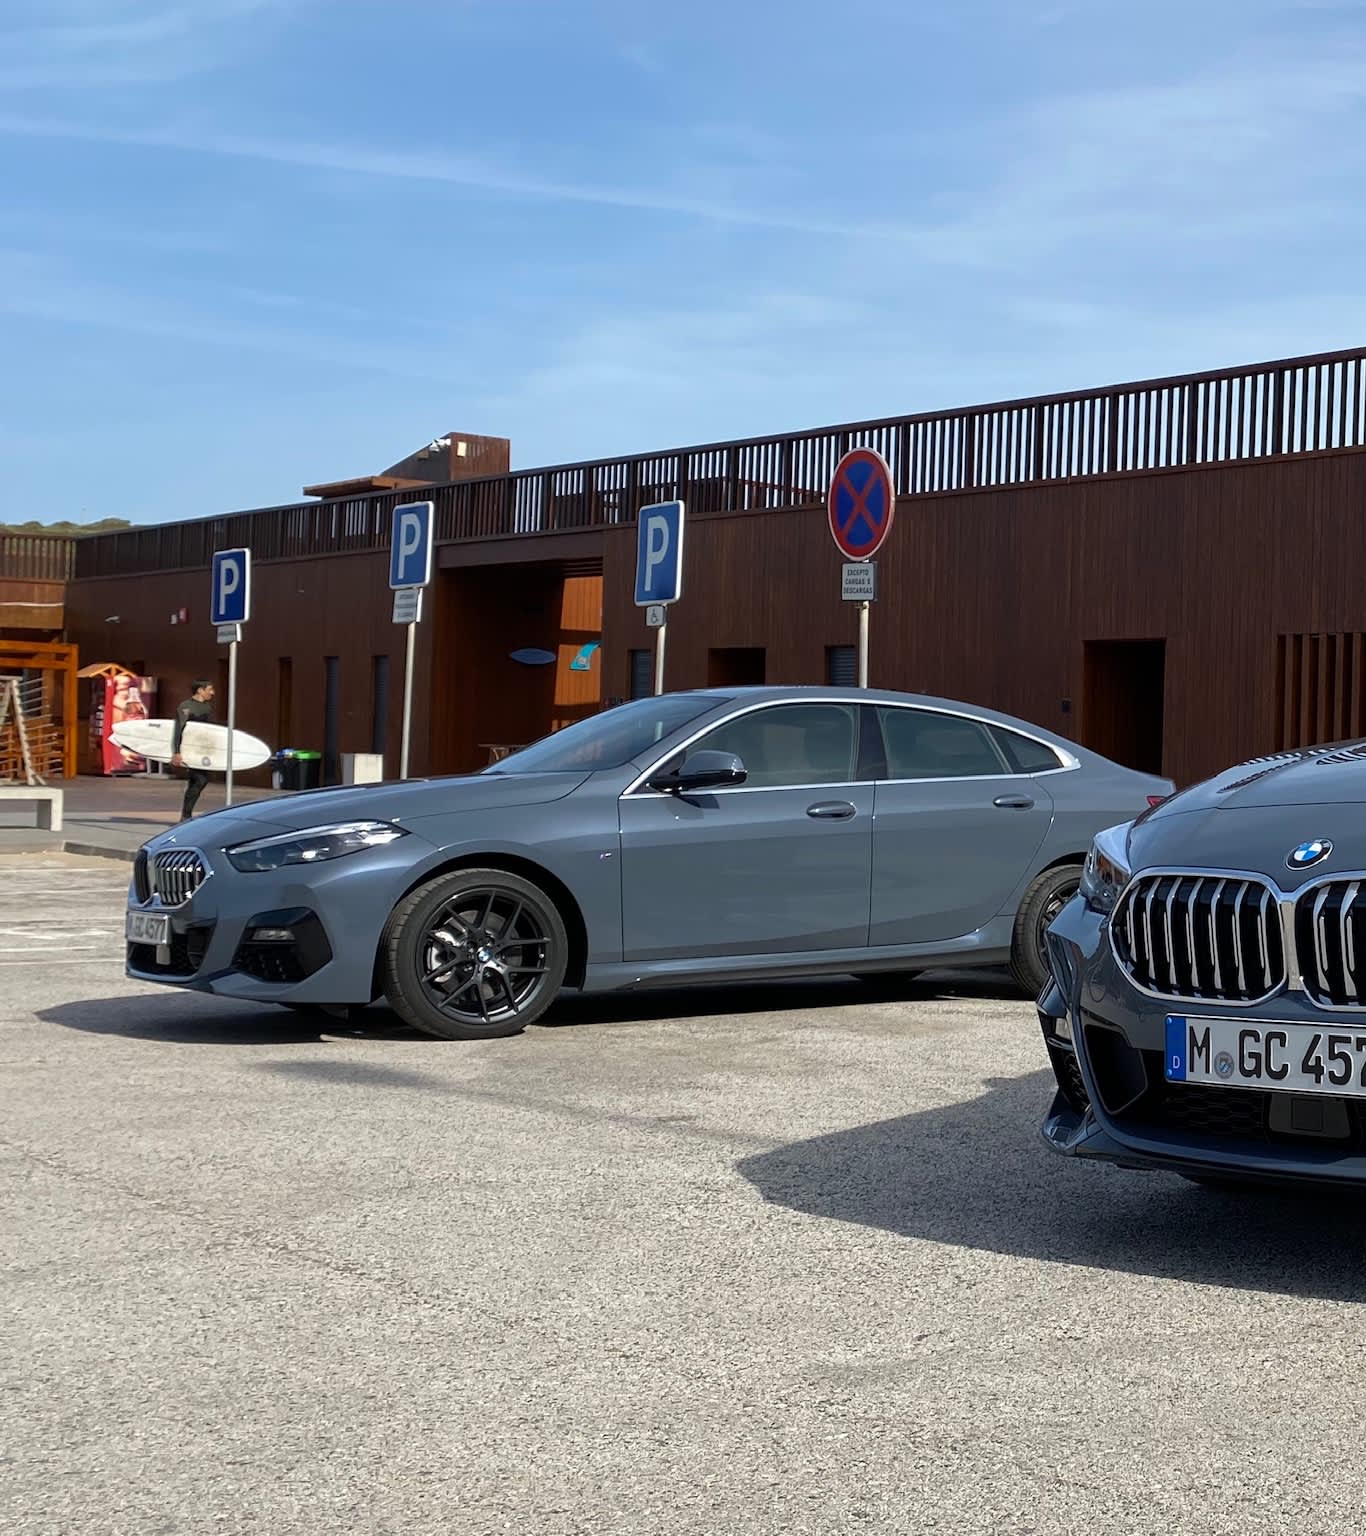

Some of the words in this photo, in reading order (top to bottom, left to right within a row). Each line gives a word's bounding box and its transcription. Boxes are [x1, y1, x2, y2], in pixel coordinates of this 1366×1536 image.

[398, 513, 421, 579] P
[644, 515, 669, 591] P
[219, 559, 240, 615] P
[1172, 1055, 1181, 1070] D
[1189, 1025, 1211, 1075] M
[1238, 1029, 1289, 1080] GC
